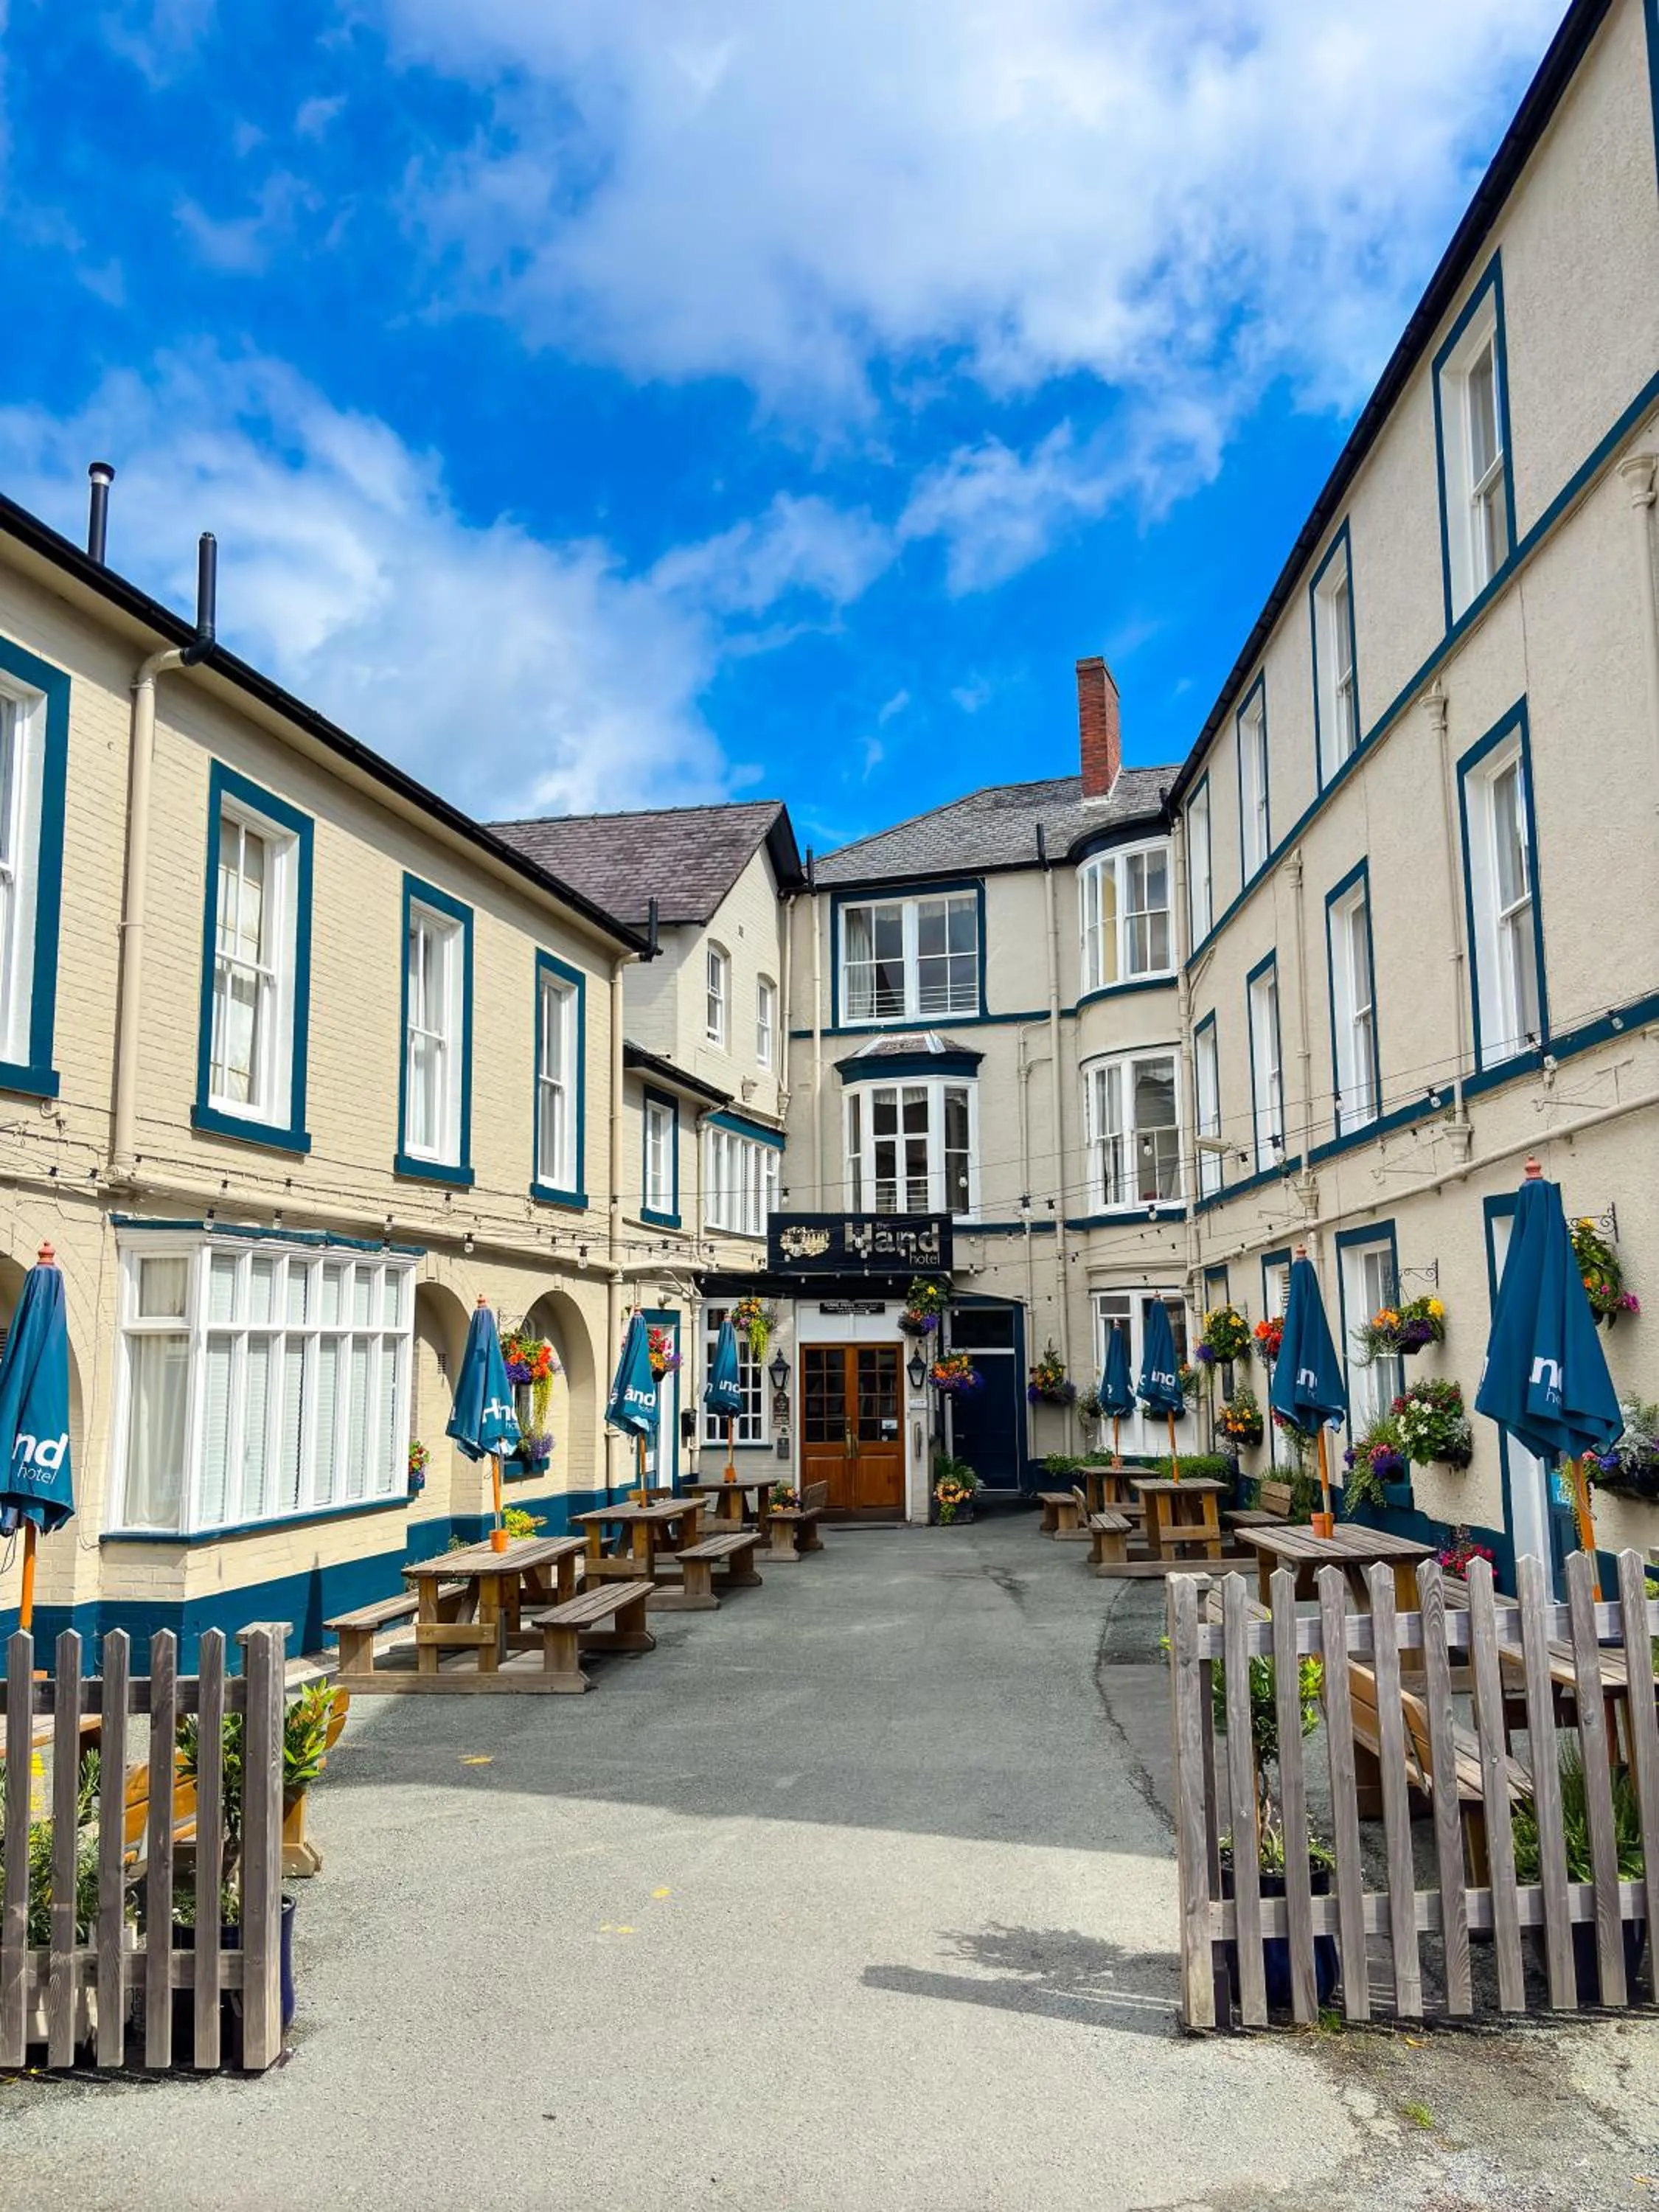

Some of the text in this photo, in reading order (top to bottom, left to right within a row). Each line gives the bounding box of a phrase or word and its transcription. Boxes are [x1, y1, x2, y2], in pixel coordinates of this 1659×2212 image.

[844, 1222, 939, 1253] Hand
[909, 1252, 940, 1265] hotel
[18, 1461, 59, 1485] hotel
